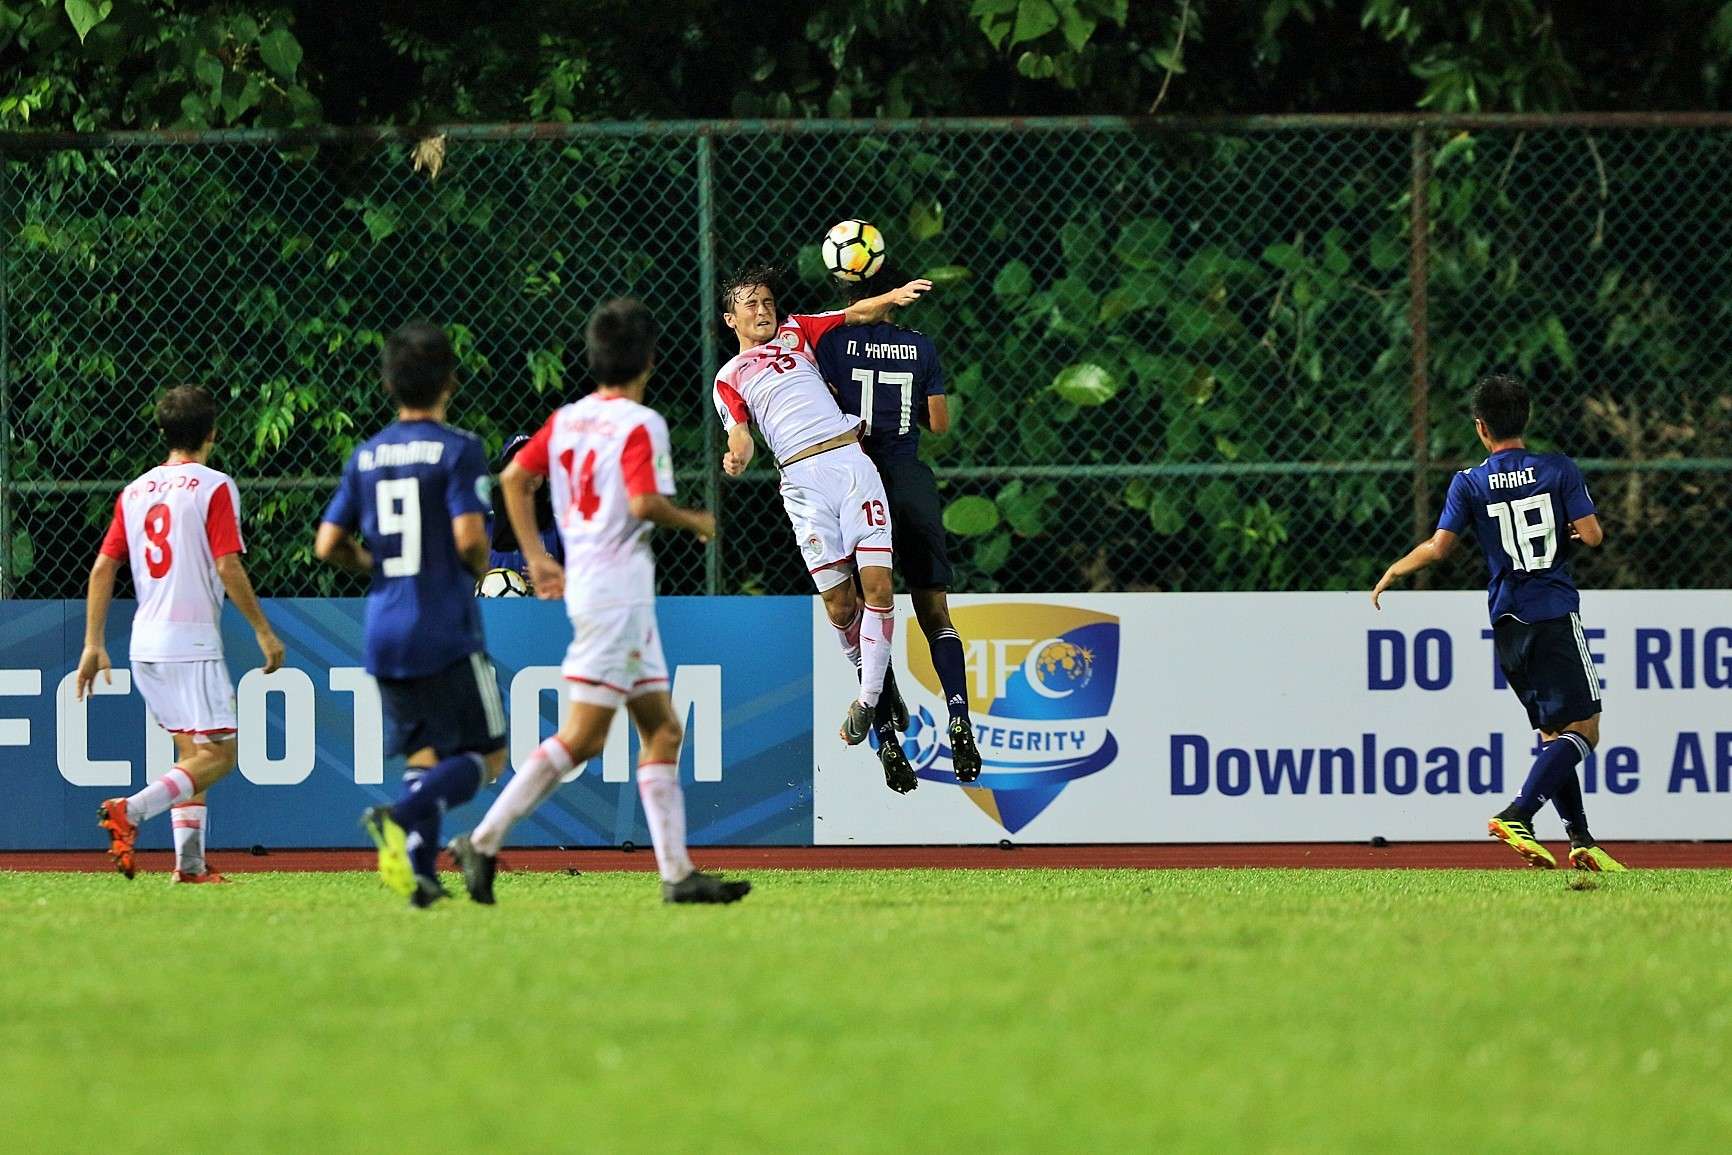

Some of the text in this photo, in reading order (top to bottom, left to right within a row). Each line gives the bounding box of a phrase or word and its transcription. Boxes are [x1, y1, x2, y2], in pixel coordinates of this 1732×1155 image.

[865, 343, 918, 361] YAMADA
[851, 367, 914, 436] 17
[1488, 466, 1537, 490] ARAKI
[144, 502, 173, 579] 8
[376, 476, 422, 578] 9
[861, 499, 887, 527] 13
[1486, 492, 1558, 573] 18
[1367, 629, 1453, 691] DO
[946, 723, 1086, 752] TEGRITY
[1170, 733, 1504, 796] Download
